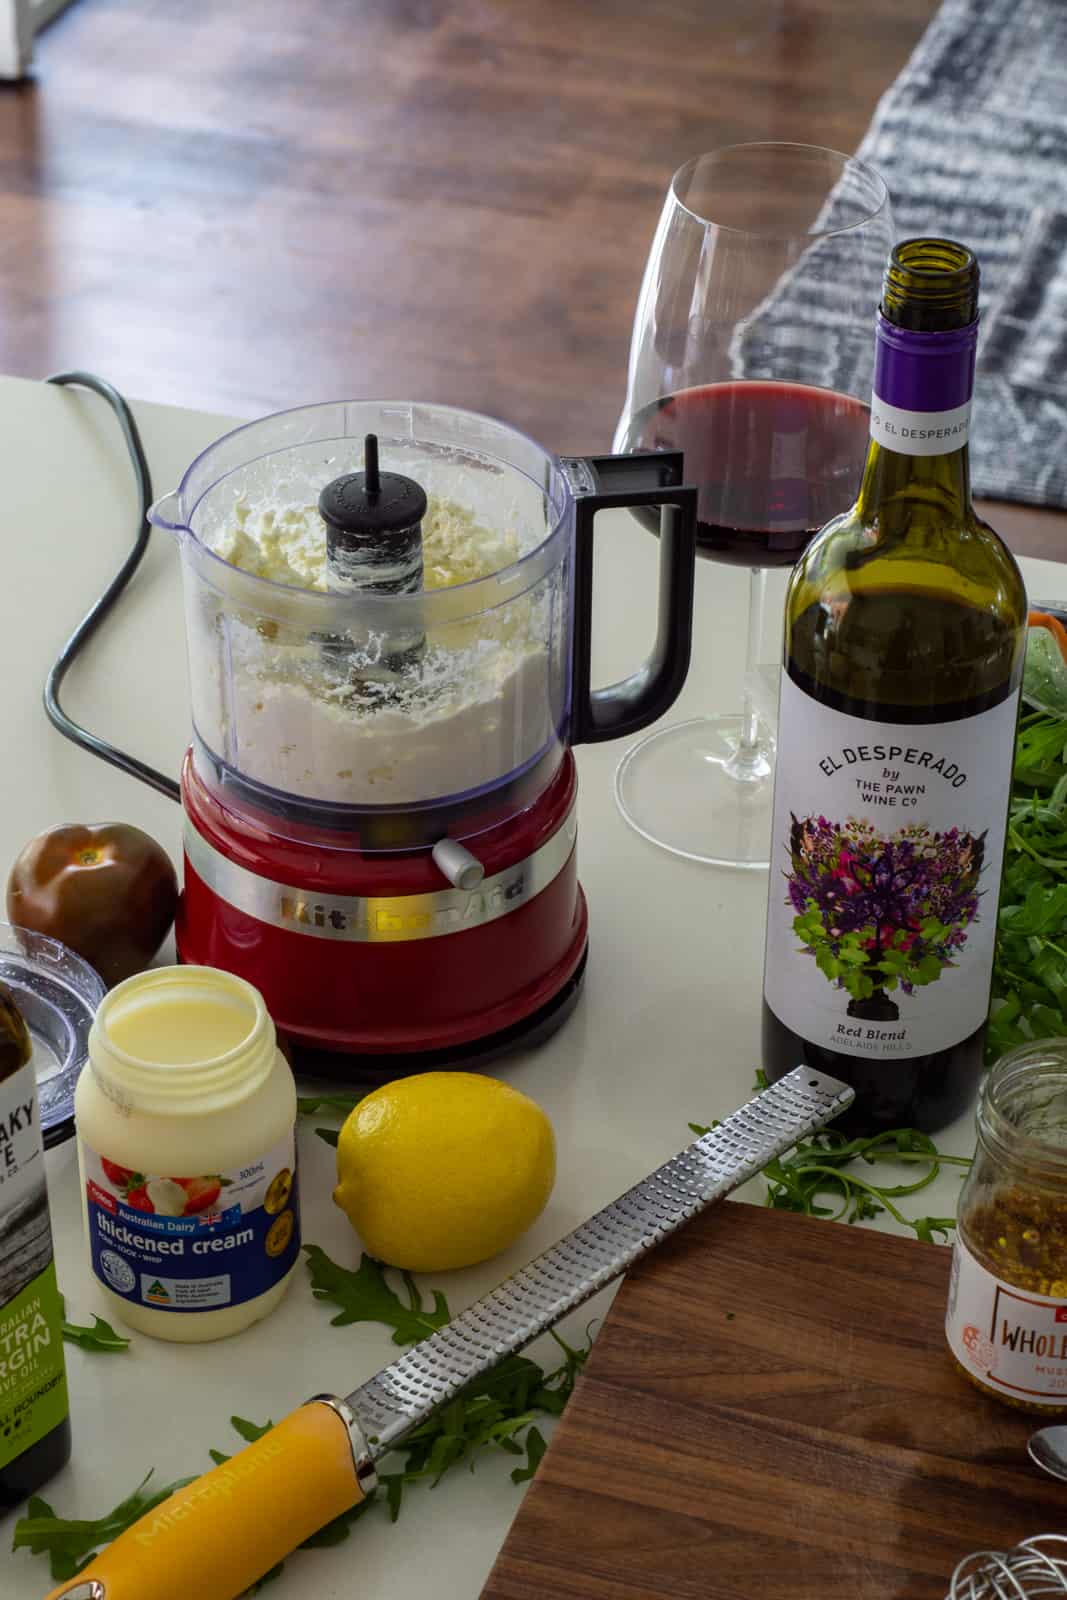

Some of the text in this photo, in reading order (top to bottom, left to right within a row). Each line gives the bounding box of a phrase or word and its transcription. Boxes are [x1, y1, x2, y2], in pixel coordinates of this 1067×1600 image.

[884, 421, 898, 435] EL
[818, 745, 967, 788] EL DESPERADO
[882, 768, 900, 781] by
[856, 779, 926, 795] THE PAWN
[862, 793, 897, 806] WINE
[836, 1023, 906, 1041] Red Blend
[119, 1208, 196, 1233] Australian Dairy
[97, 1211, 185, 1256] thickened
[192, 1228, 255, 1254] cream
[0, 1312, 47, 1355] TRA
[21, 1358, 40, 1377] OIL
